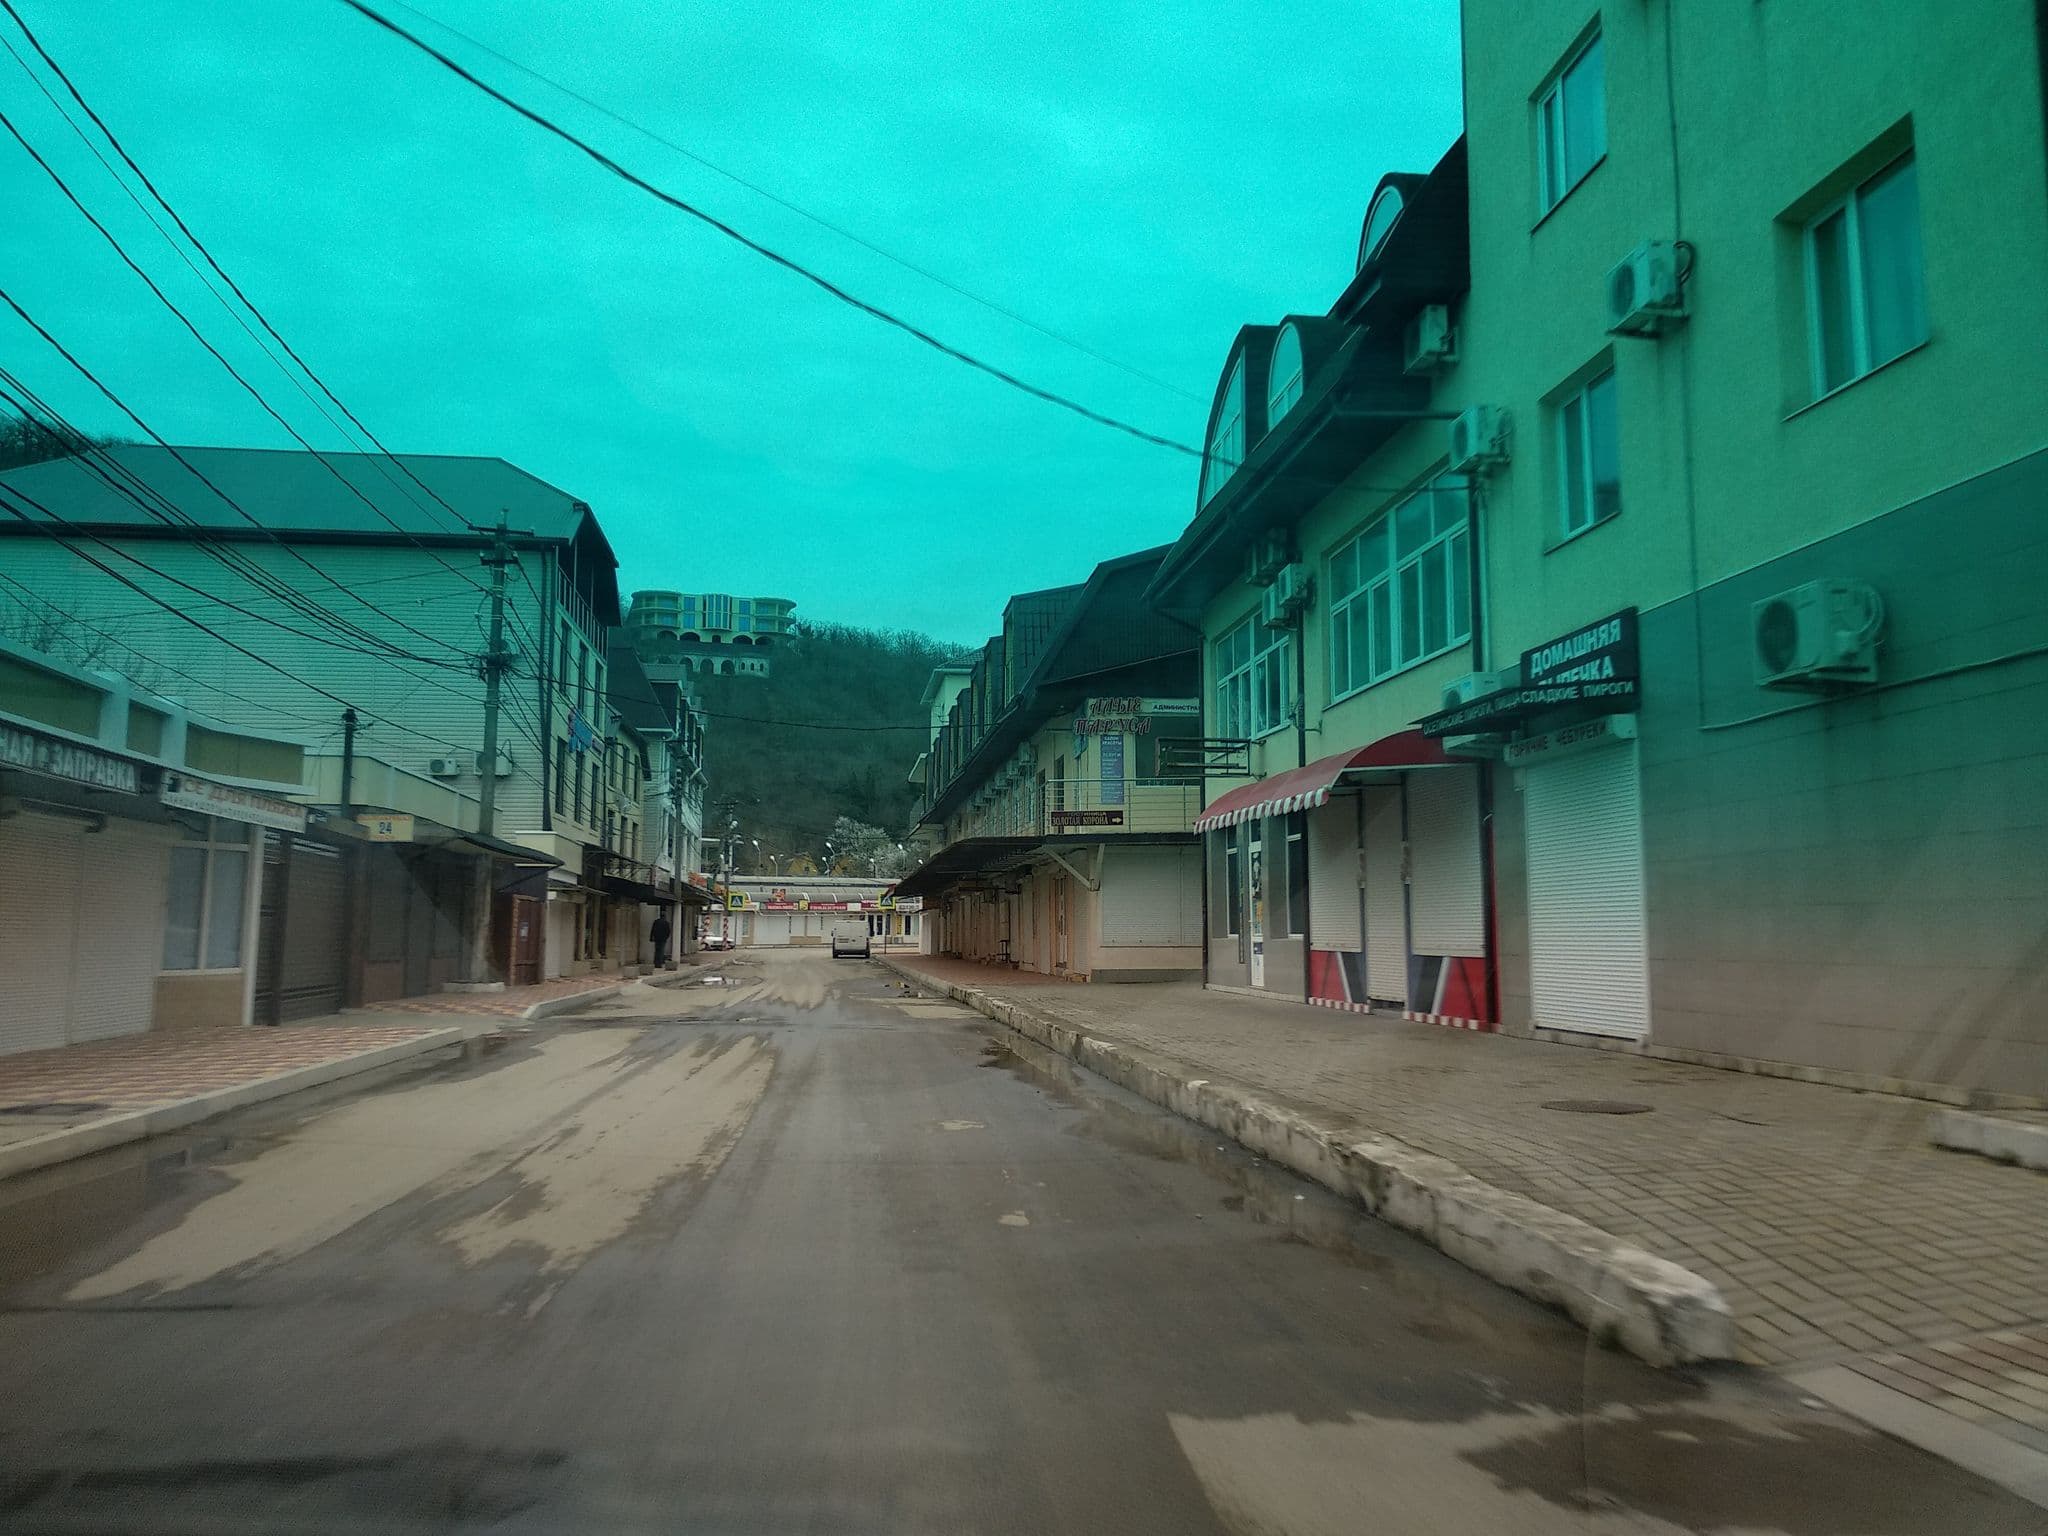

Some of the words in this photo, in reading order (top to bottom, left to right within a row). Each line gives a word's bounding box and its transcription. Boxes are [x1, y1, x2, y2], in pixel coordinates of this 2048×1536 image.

[1530, 618, 1621, 679] ДОМАШНЯЯ
[1520, 686, 1580, 703] СЛАДКИЕ
[1583, 681, 1633, 697] ПИРОГИ
[1090, 697, 1142, 715] АЛЫЕ
[1153, 704, 1200, 713] АДМИНИСТРА
[1073, 717, 1152, 736] ПАРУСА
[51, 743, 136, 792] ЗАПРАВКА
[379, 821, 392, 834] 24
